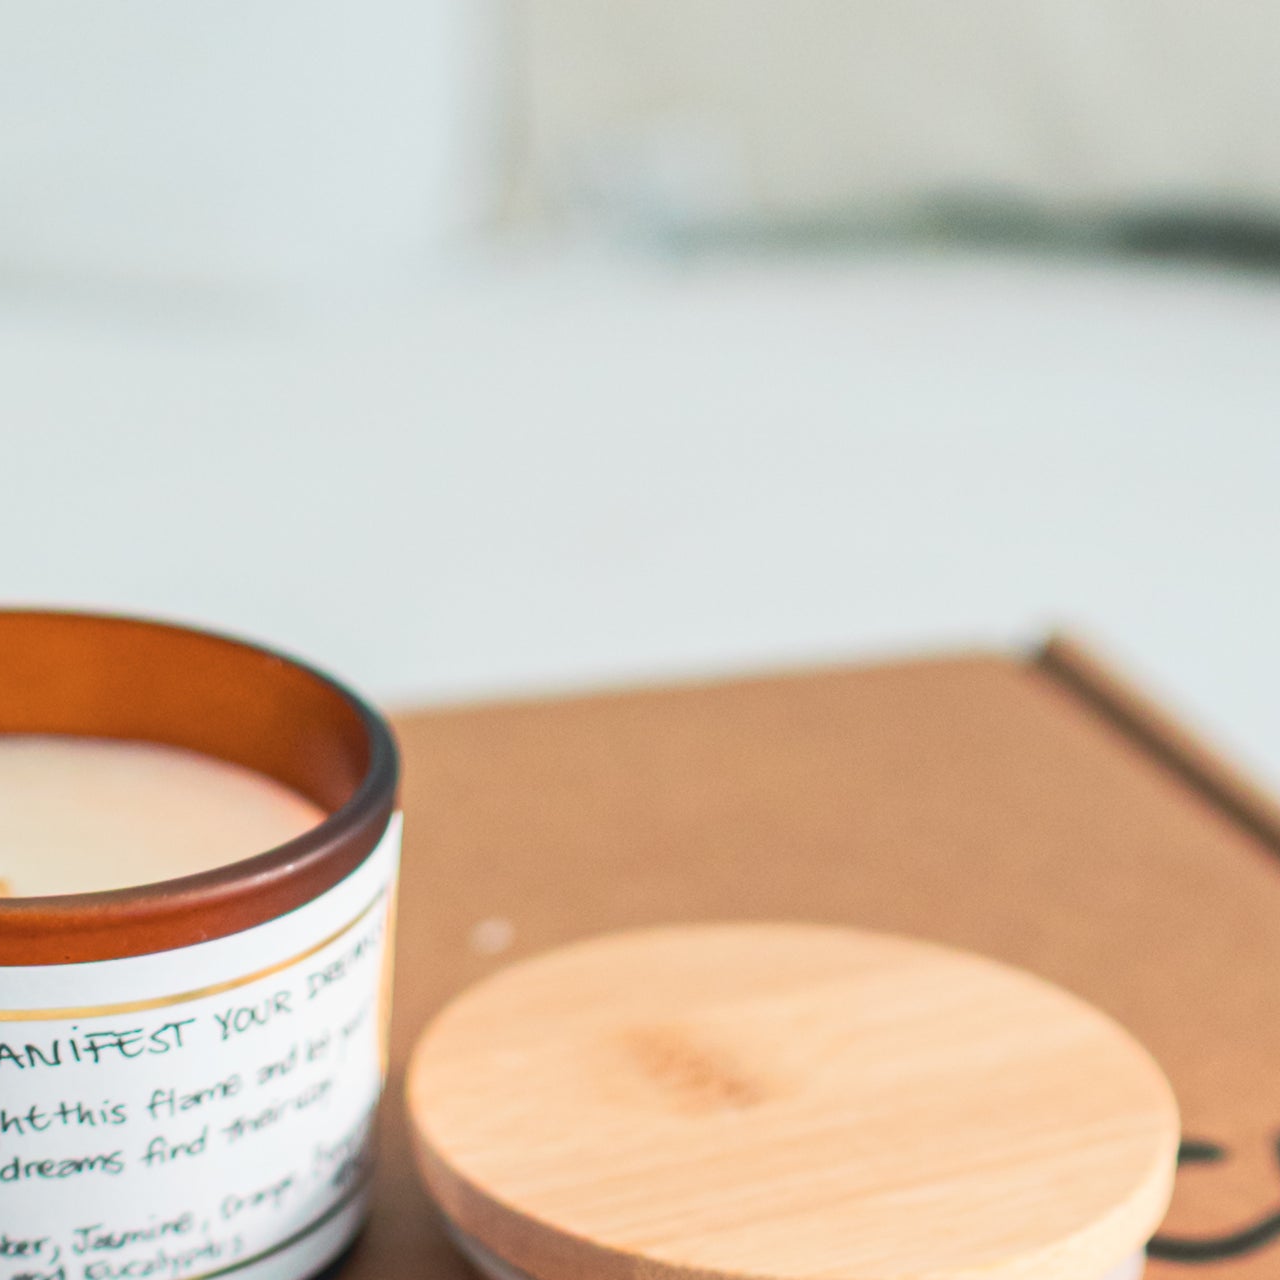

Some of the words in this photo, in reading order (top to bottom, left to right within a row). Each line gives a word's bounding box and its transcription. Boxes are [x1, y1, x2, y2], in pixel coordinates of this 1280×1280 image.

[214, 989, 293, 1041] YOUR
[50, 1100, 127, 1127] this
[147, 1073, 241, 1119] flame
[141, 1124, 209, 1168] find
